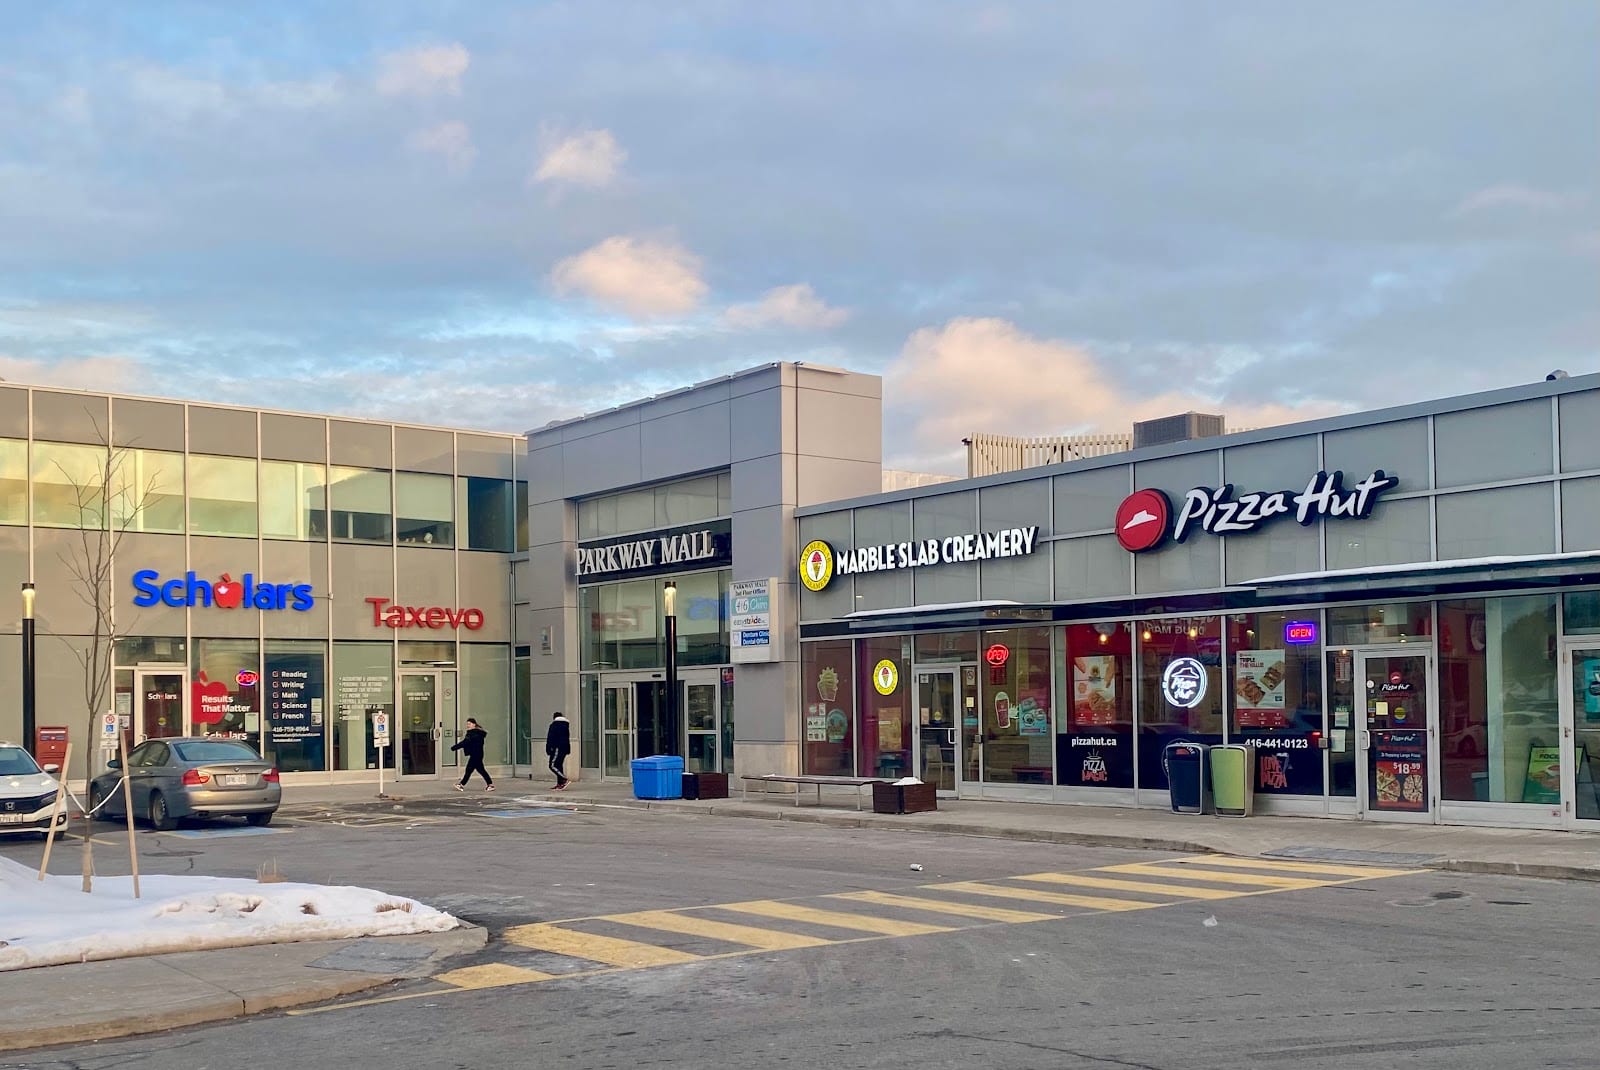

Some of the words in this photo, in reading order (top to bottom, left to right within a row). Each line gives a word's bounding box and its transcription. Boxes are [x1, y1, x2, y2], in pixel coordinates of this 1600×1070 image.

[1174, 486, 1288, 541] Pizza
[1293, 472, 1390, 523] Hut
[575, 538, 656, 576] PARKWAY
[660, 530, 714, 565] MALL
[836, 543, 895, 576] MARBLE
[898, 539, 939, 568] SLAB
[942, 525, 1038, 564] CREAMERY
[132, 569, 315, 611] Scholars
[365, 597, 484, 630] Taxevo
[1290, 628, 1312, 638] OPEN
[986, 649, 1008, 661] OPEN
[281, 671, 308, 679] Reading
[281, 681, 304, 689] Writing
[201, 695, 234, 703] Results
[201, 704, 221, 712] That
[222, 704, 250, 712] Matter
[1071, 736, 1117, 747] pizzahut.ca
[1245, 738, 1308, 749] 416-441-0123
[1083, 759, 1106, 771] PIZZA
